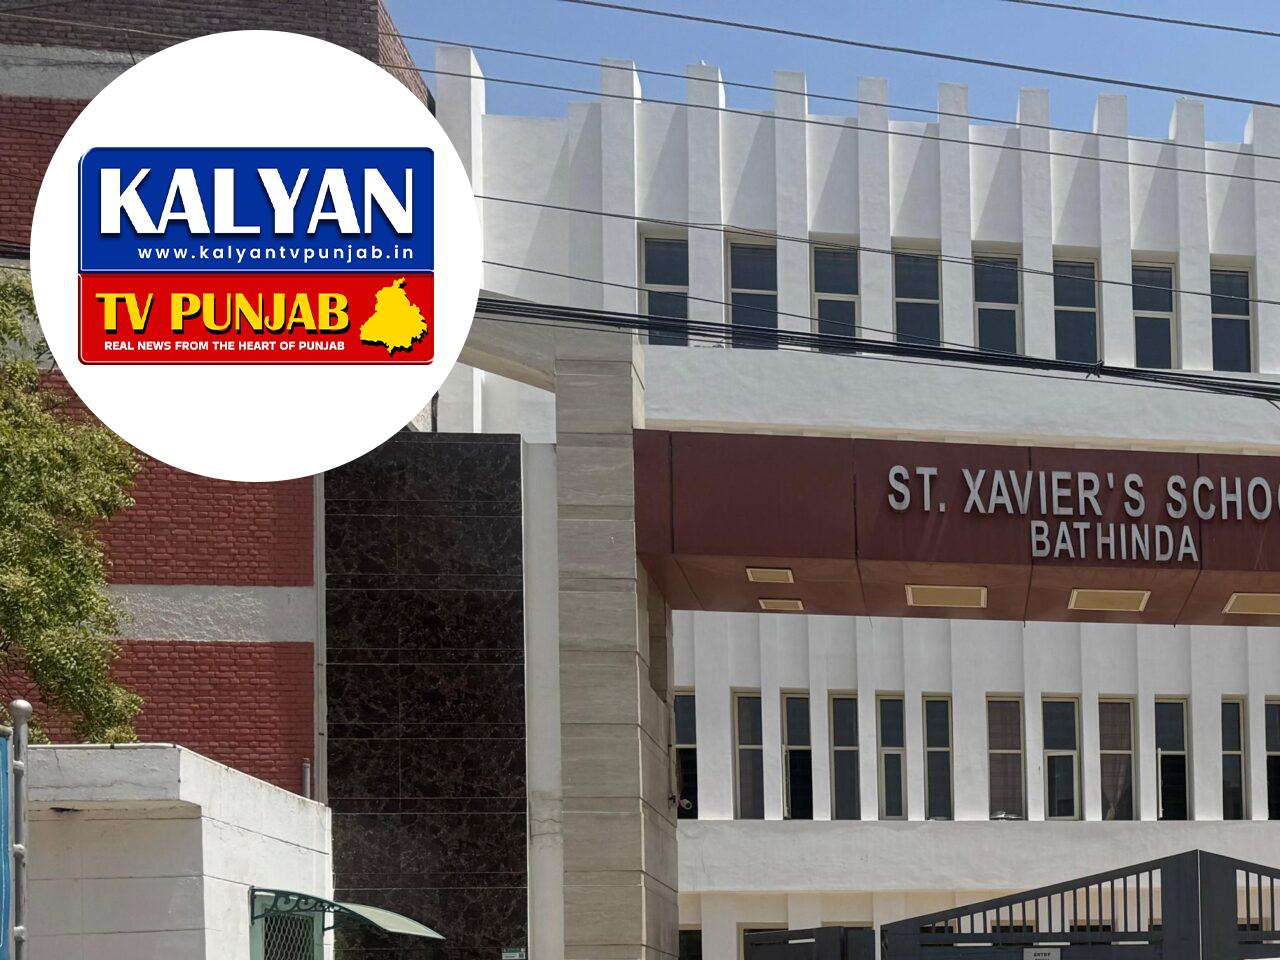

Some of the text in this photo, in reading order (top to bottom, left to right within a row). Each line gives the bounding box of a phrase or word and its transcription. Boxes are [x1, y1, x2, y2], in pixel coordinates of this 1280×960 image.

[887, 465, 946, 513] ST.
[961, 468, 1145, 519] XAVIER'S
[1030, 519, 1200, 562] BATHINDA
